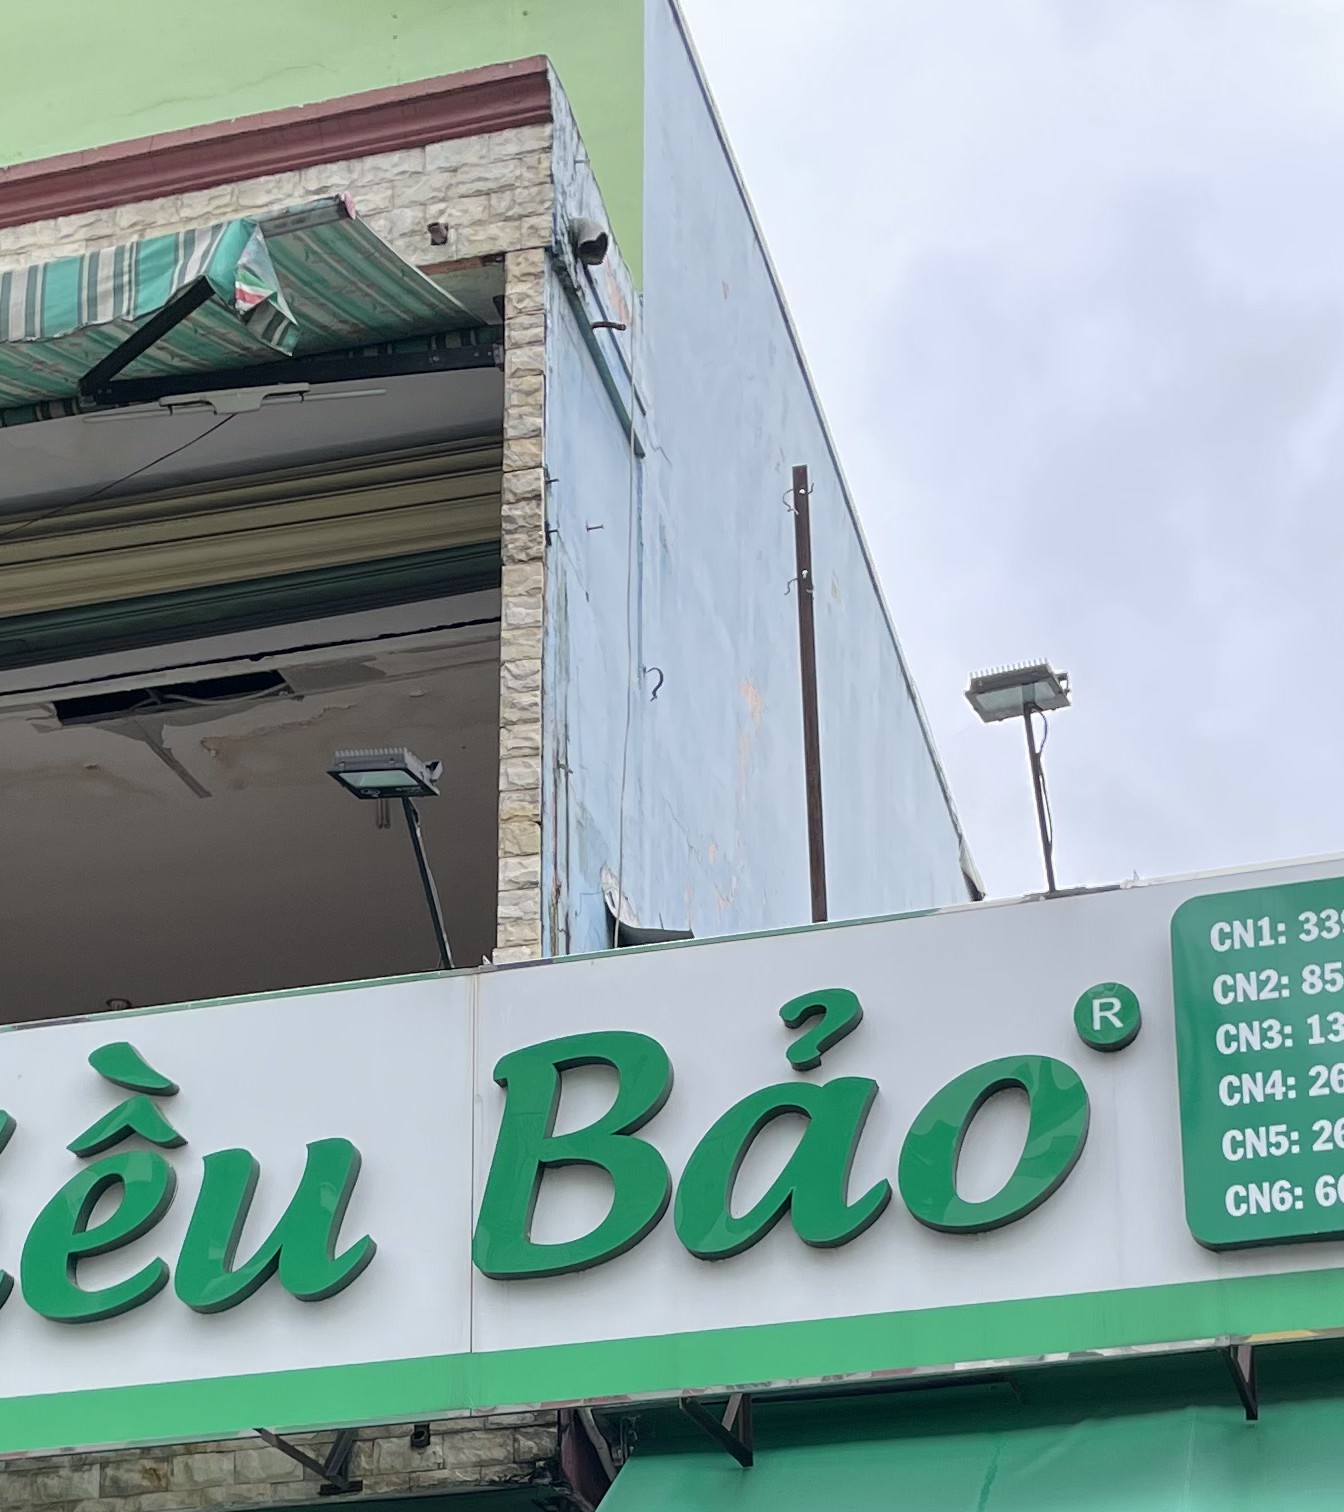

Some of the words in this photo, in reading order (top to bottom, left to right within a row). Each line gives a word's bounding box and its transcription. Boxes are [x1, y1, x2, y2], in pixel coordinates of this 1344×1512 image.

[1211, 917, 1286, 951] CN1:
[1213, 969, 1289, 1004] CN2:
[1216, 1019, 1292, 1054] CN3:
[1219, 1070, 1296, 1106] CN4:
[472, 987, 1091, 1281] Bảo
[1223, 1125, 1299, 1161] CN5:
[1226, 1180, 1303, 1216] CN6:
